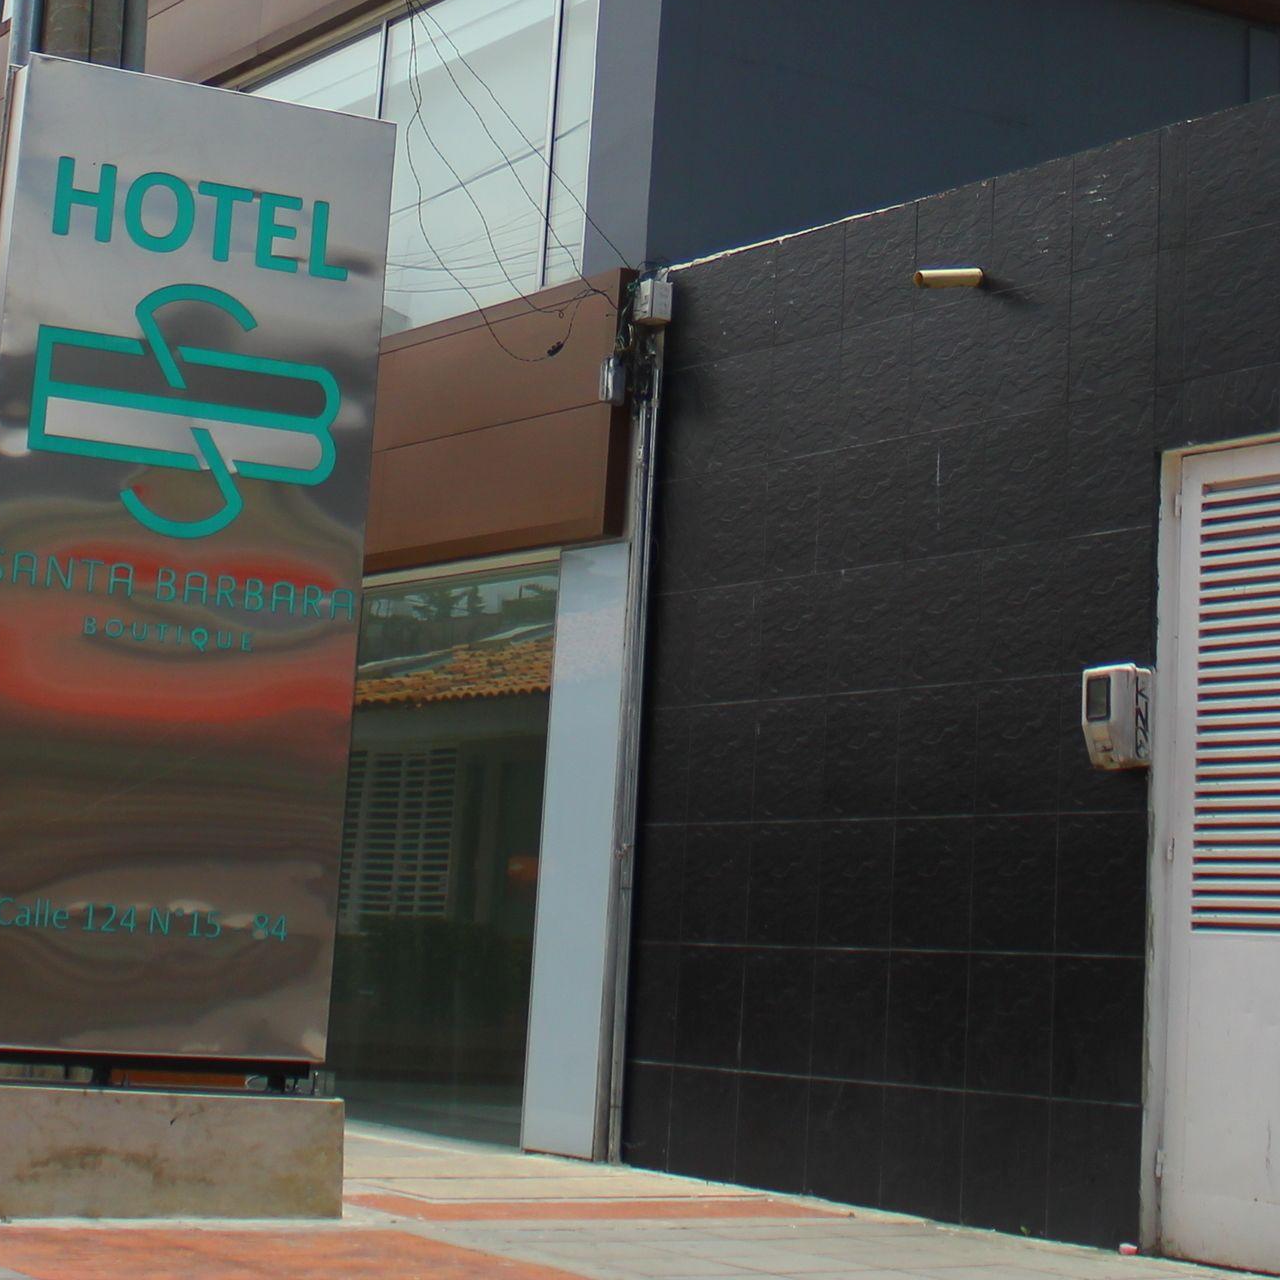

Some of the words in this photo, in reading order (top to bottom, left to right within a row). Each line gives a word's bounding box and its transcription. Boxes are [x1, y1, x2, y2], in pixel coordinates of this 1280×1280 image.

[51, 156, 349, 281] HOTEL
[155, 567, 355, 620] BARBARA
[83, 616, 254, 653] BOUTIQUE
[81, 903, 138, 933] 124
